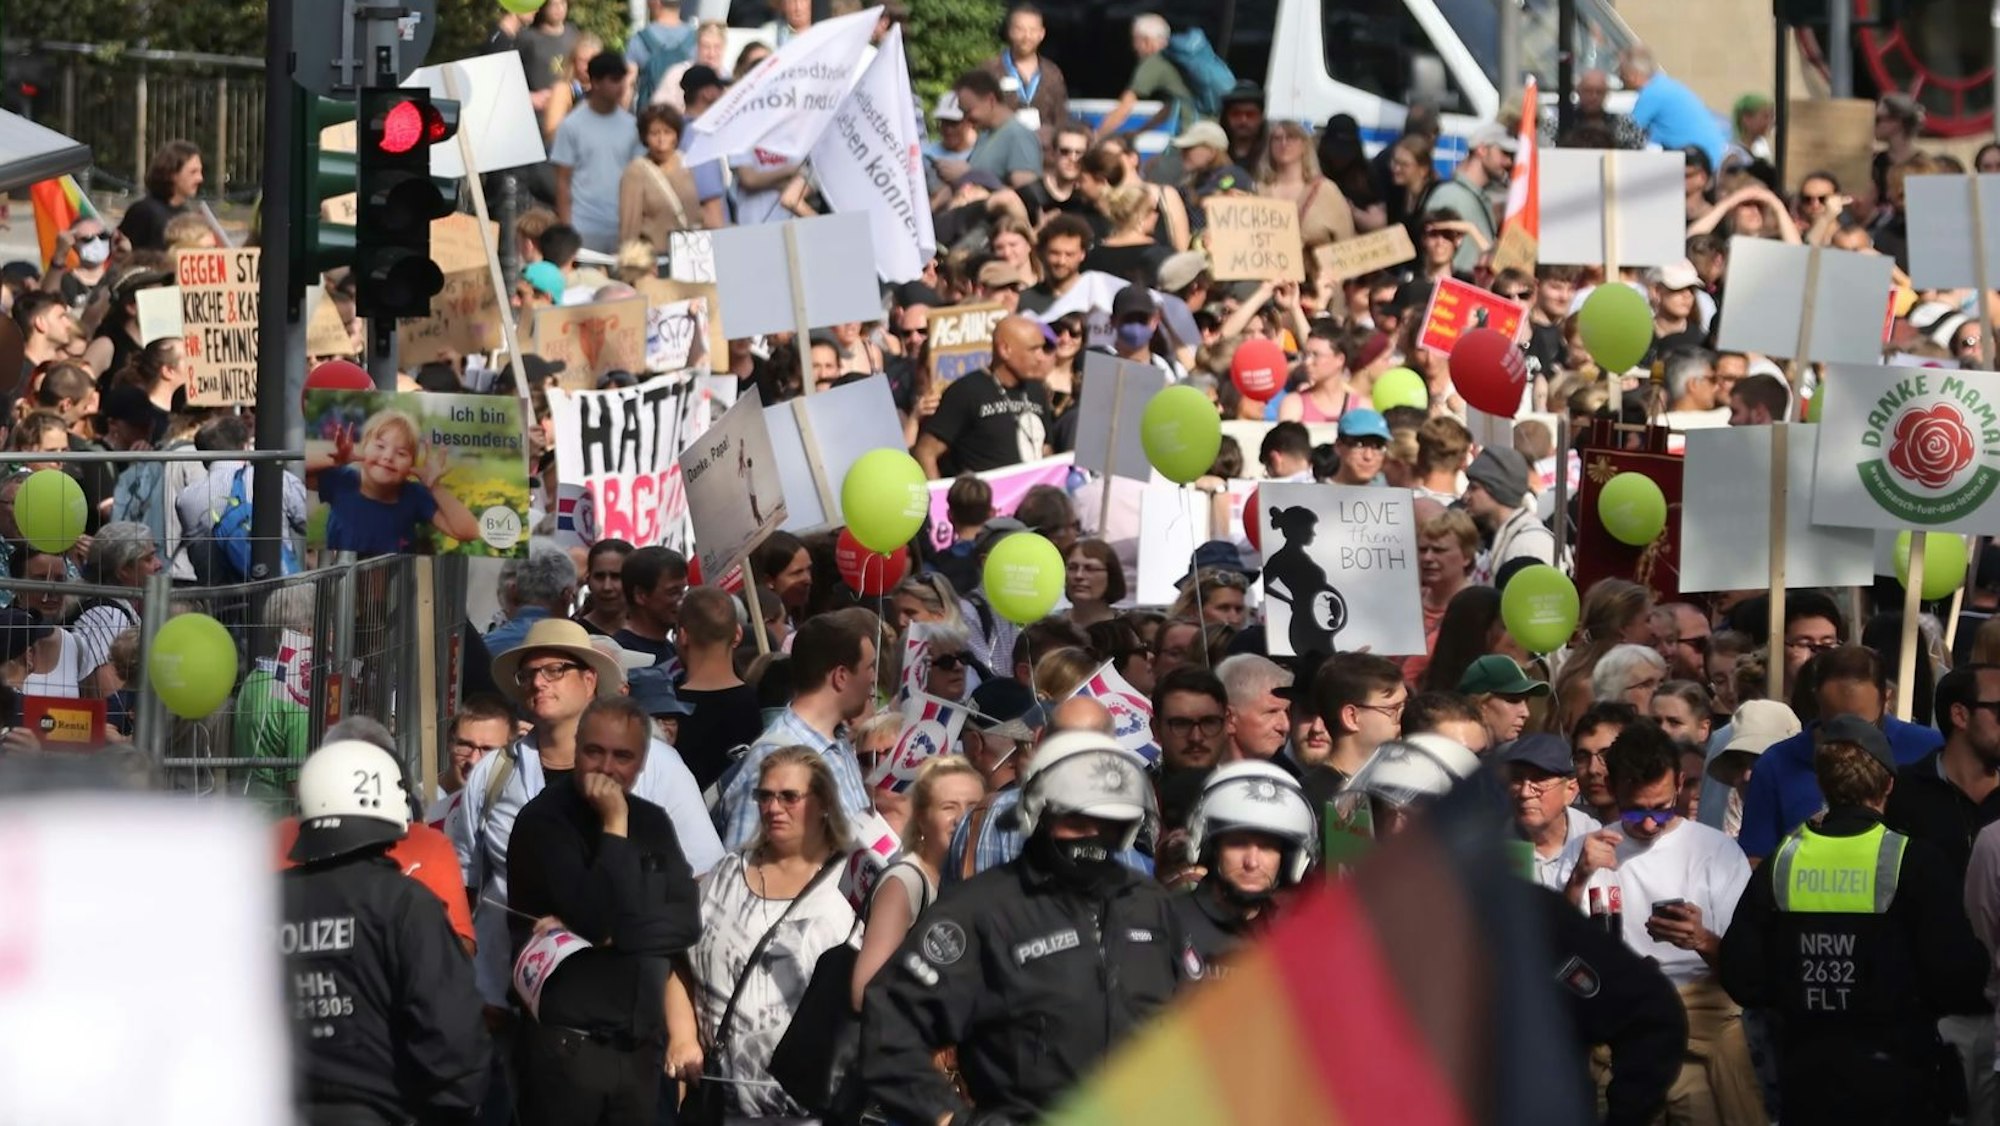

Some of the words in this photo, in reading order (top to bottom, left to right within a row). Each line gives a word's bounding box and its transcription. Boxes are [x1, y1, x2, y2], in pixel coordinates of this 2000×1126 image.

[1211, 205, 1292, 230] WICHSEN
[1251, 233, 1273, 249] IST
[179, 255, 227, 285] GEGEN
[1231, 252, 1289, 273] MORD
[183, 292, 225, 323] KIRCHE
[227, 291, 238, 323] &
[188, 366, 198, 398] &
[451, 406, 474, 422] Ich
[480, 408, 505, 424] bin
[1861, 375, 1929, 447] DANKE
[432, 430, 523, 449] besonders!
[687, 457, 712, 483] Danke,
[710, 433, 731, 460] Papa!
[1870, 465, 1989, 514] www.marsch-fuer-das-leben.de
[1340, 501, 1401, 525] LOVE
[1348, 525, 1401, 544] them
[1340, 547, 1406, 570] BOTH
[58, 720, 89, 730] Rental
[353, 769, 382, 796] 21
[1796, 869, 1869, 894] POLIZEI
[280, 917, 356, 955] OLIZEI
[1018, 929, 1080, 964] POLIZEI
[1800, 933, 1857, 956] NRW
[1802, 960, 1856, 983] 2632
[295, 972, 338, 997] HH
[1806, 987, 1851, 1010] FLT
